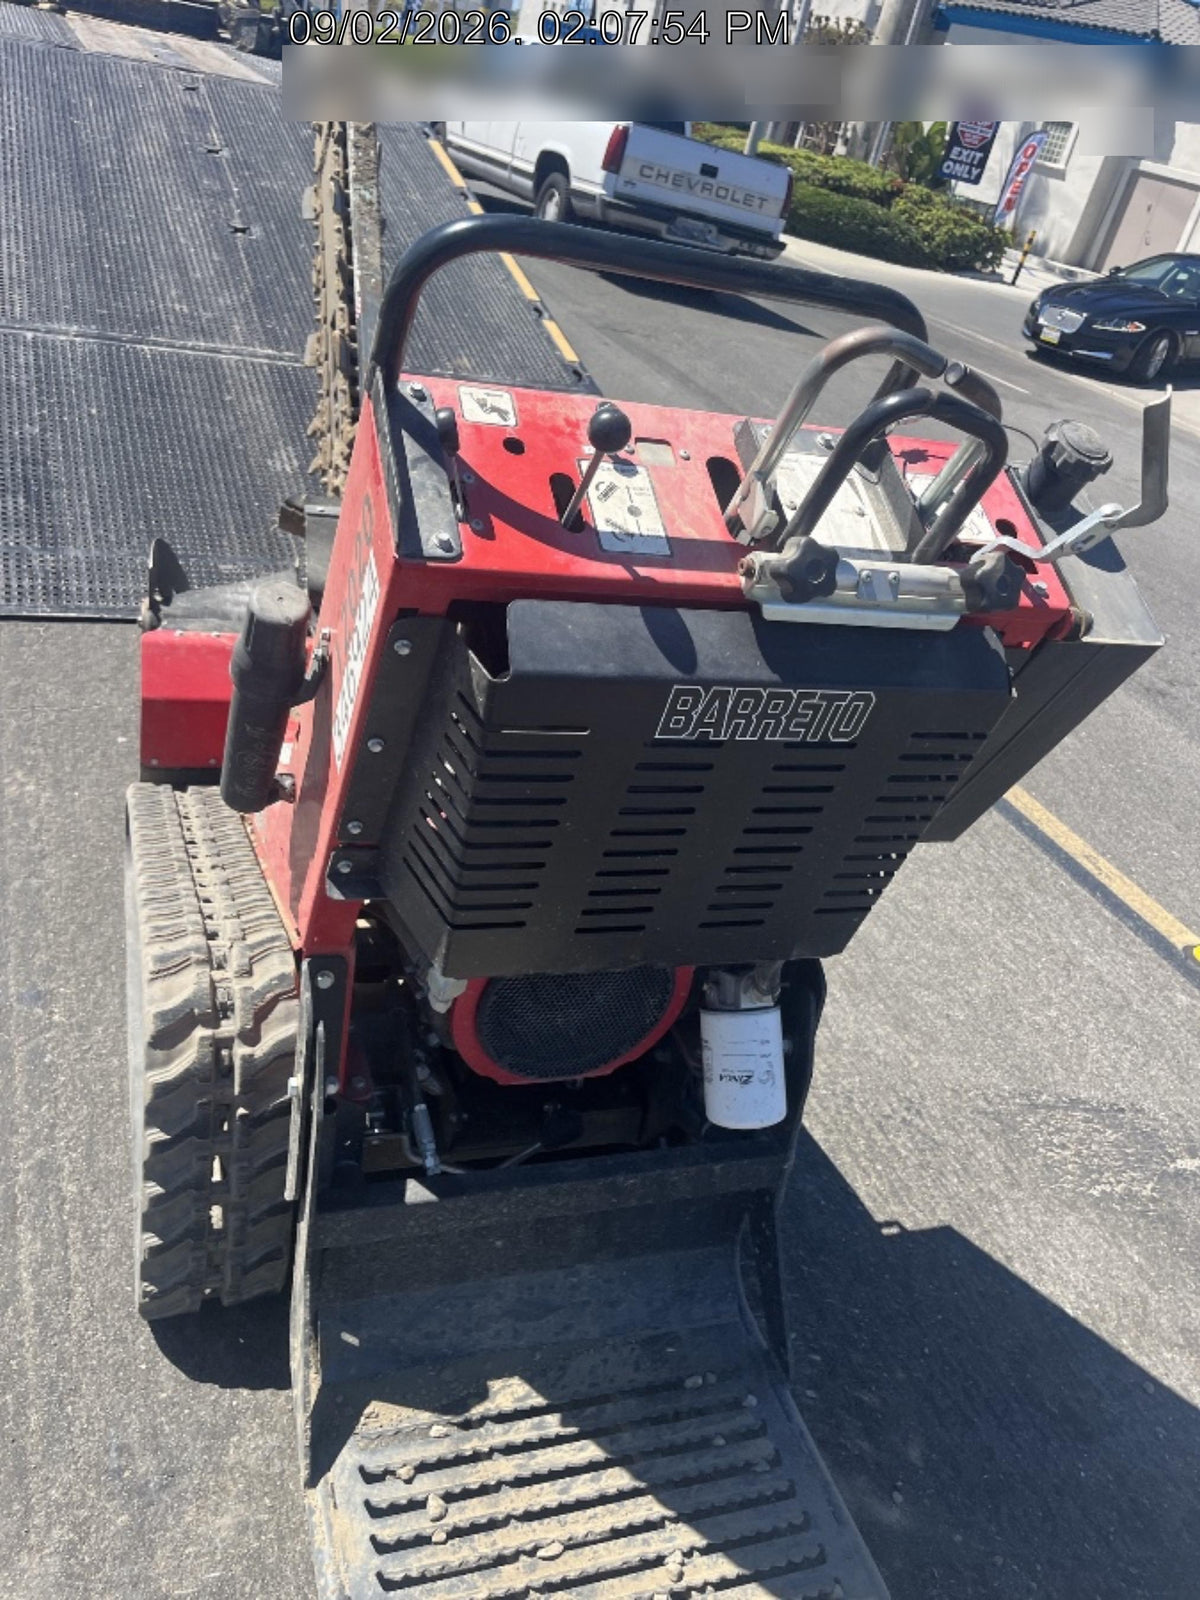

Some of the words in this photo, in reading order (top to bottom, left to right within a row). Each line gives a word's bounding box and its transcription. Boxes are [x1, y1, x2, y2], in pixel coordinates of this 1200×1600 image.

[942, 161, 981, 180] ONLY
[949, 146, 984, 165] EXIT
[1003, 141, 1038, 213] OPEN
[639, 163, 769, 210] CHEVROLET
[654, 684, 877, 742] BARRETO
